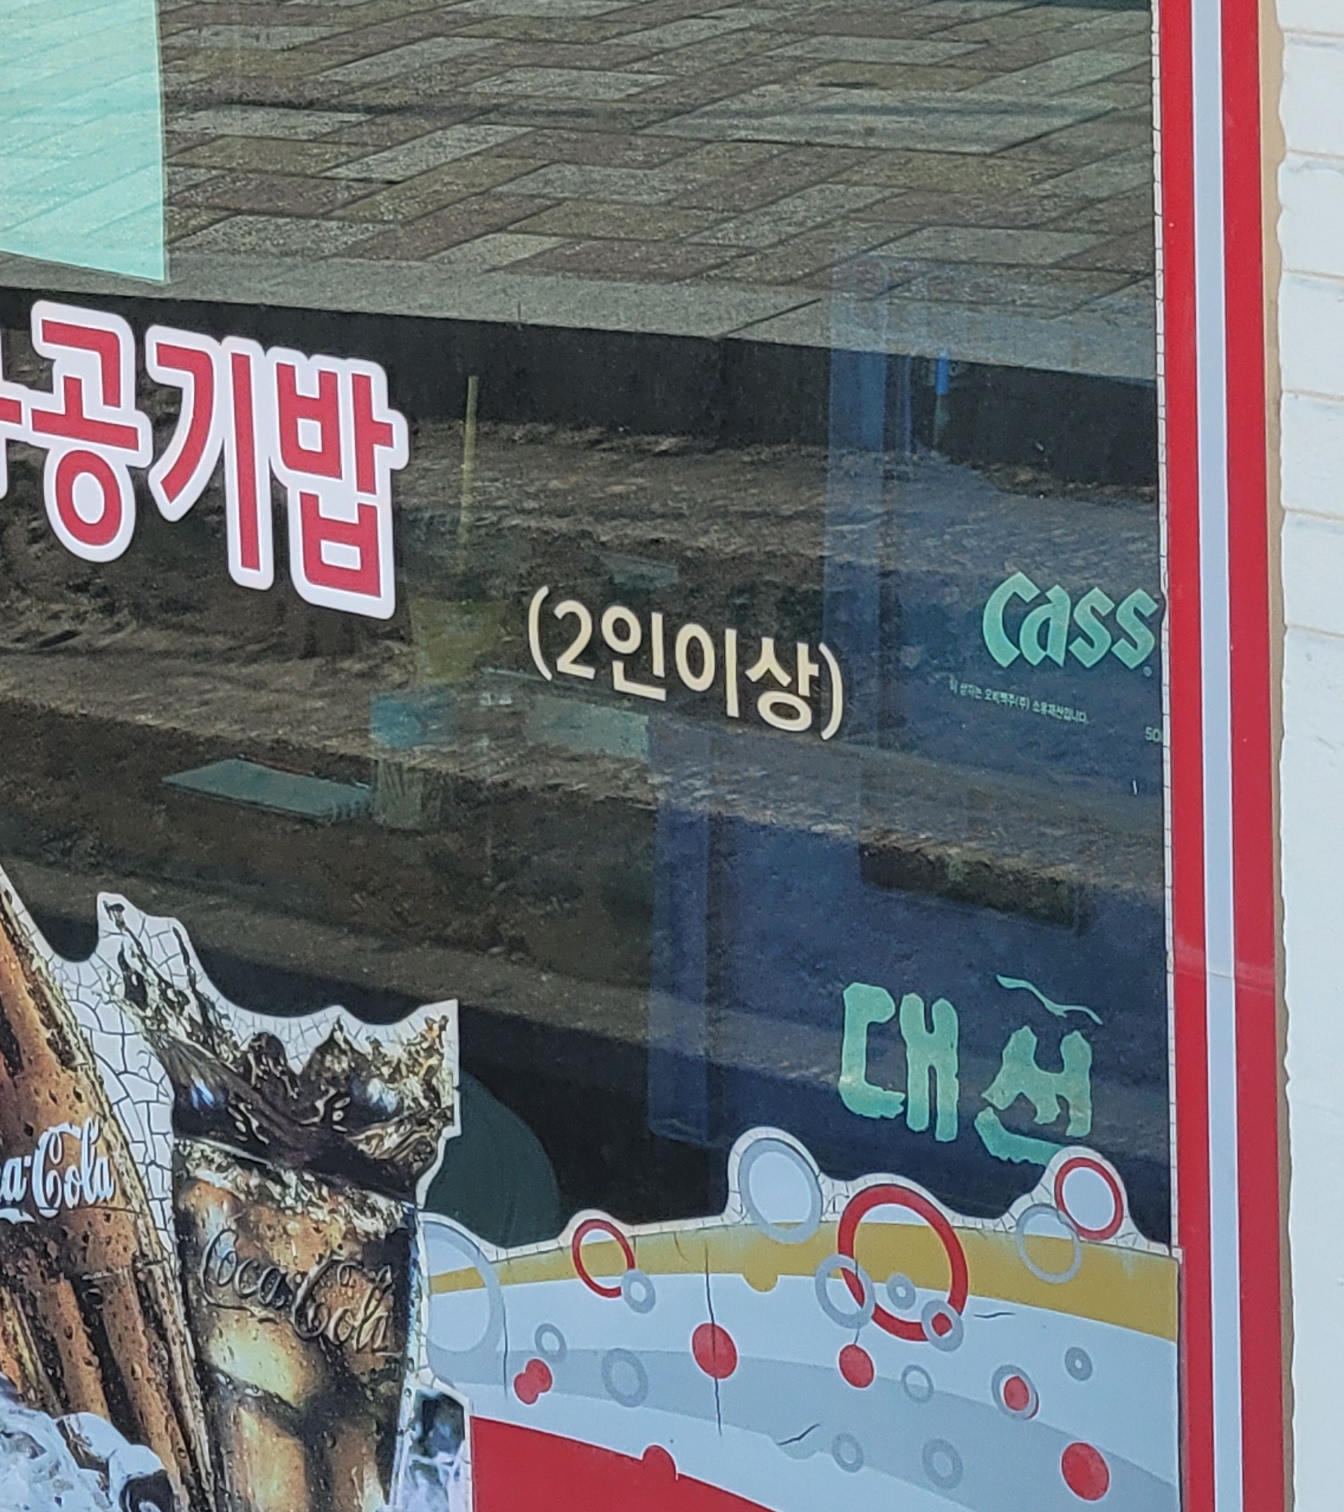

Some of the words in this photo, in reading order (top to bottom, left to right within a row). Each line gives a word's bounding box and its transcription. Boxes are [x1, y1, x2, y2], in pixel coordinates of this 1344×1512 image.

[528, 586, 843, 740] (2인이상)
[982, 571, 1159, 669] Cass
[1145, 725, 1163, 742] 50
